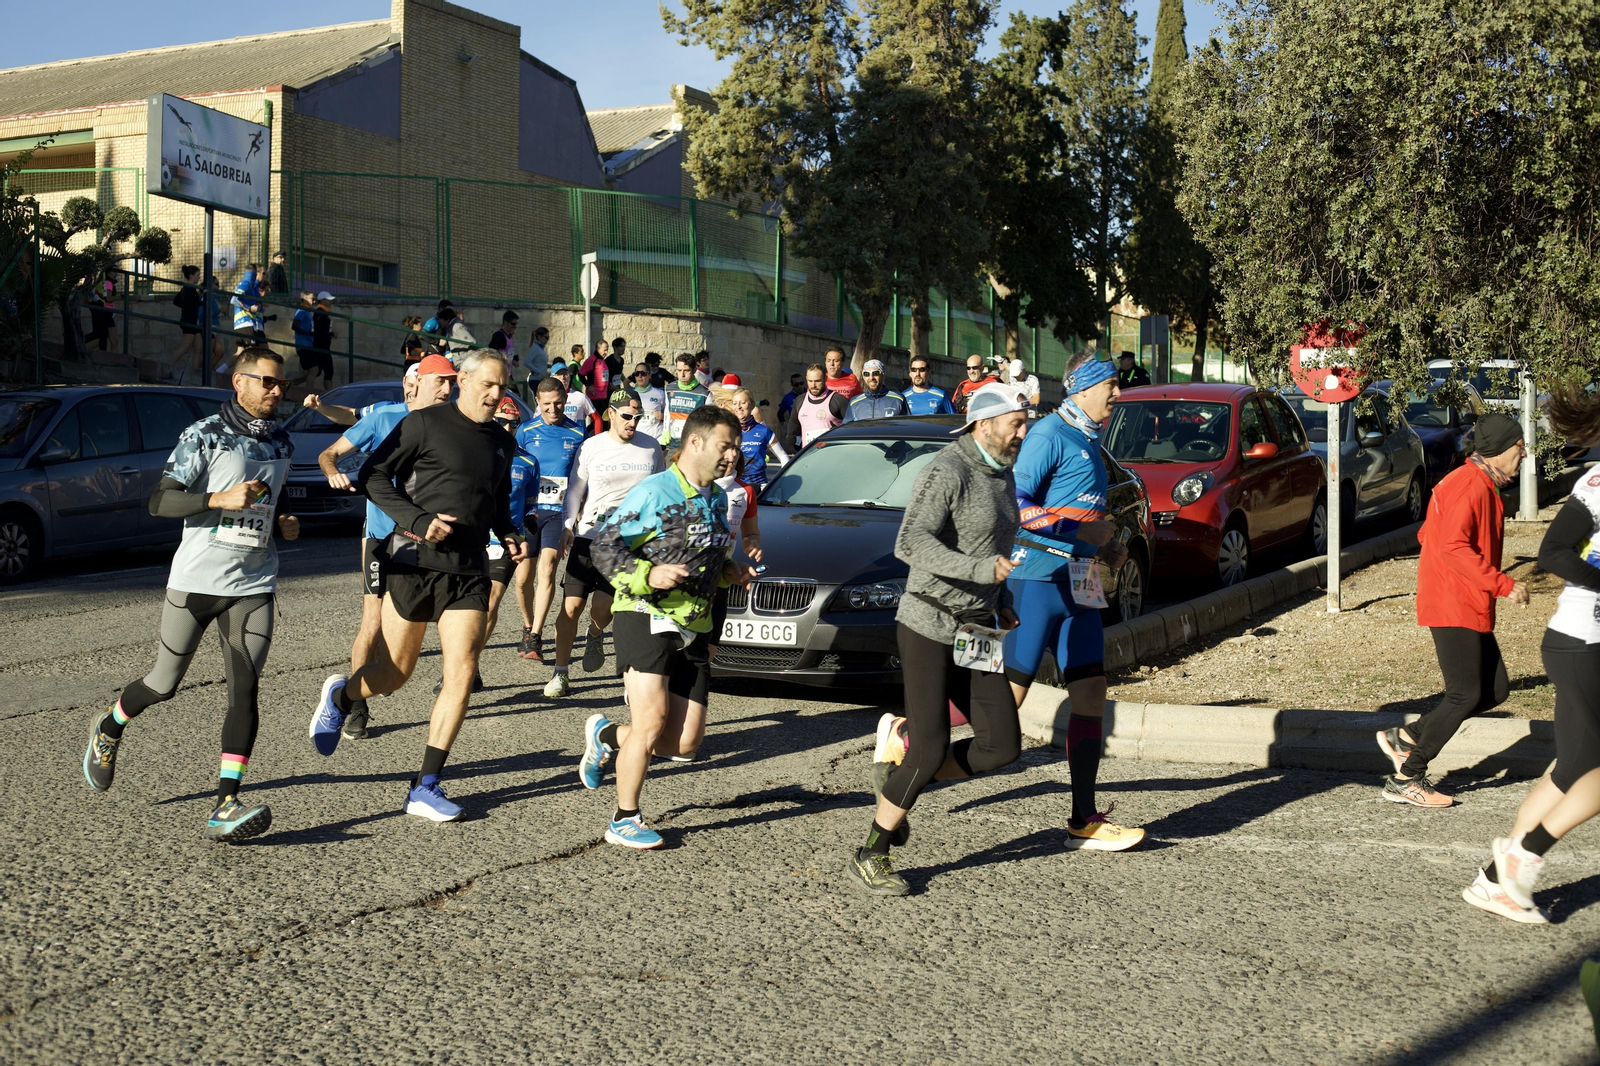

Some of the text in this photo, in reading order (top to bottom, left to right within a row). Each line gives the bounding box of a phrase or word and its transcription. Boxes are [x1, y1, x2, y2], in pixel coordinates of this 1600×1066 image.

[222, 151, 242, 163] MUNICIPALES
[178, 148, 252, 186] LA SALOBREJA
[540, 485, 559, 494] 115
[237, 516, 264, 532] 112
[724, 622, 792, 642] 812 GCG
[969, 637, 991, 654] 110
